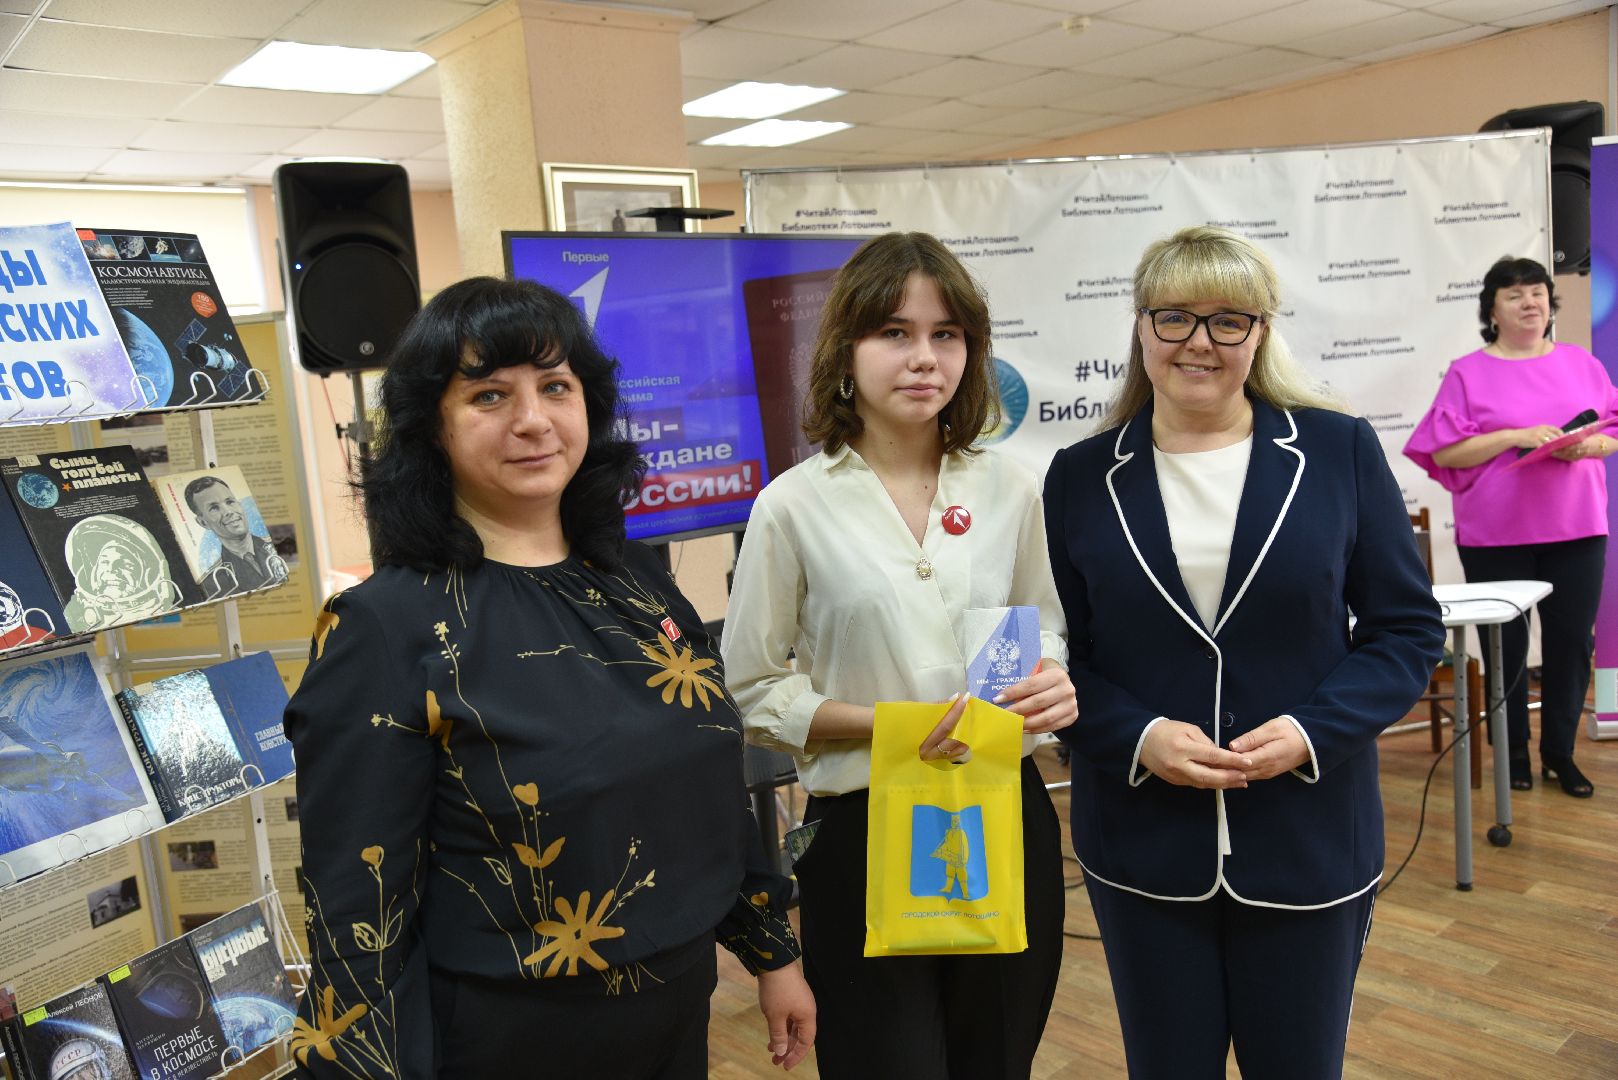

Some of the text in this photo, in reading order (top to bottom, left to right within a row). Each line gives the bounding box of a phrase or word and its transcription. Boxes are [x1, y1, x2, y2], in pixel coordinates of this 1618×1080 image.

[795, 207, 878, 217] #ЧитайЛотошино
[781, 221, 892, 232] Библиотеки Лотошинья
[562, 251, 609, 265] Первые
[96, 266, 208, 279] КОСМОНАВТИКА
[0, 299, 100, 342] СКИХ
[618, 374, 681, 390] ссийская
[49, 455, 98, 470] Сыны
[60, 461, 125, 480] голубой
[71, 472, 141, 490] планеты
[153, 1025, 204, 1061] ПЕРВЫЕ
[161, 1034, 218, 1075] КОСМОСЕ
